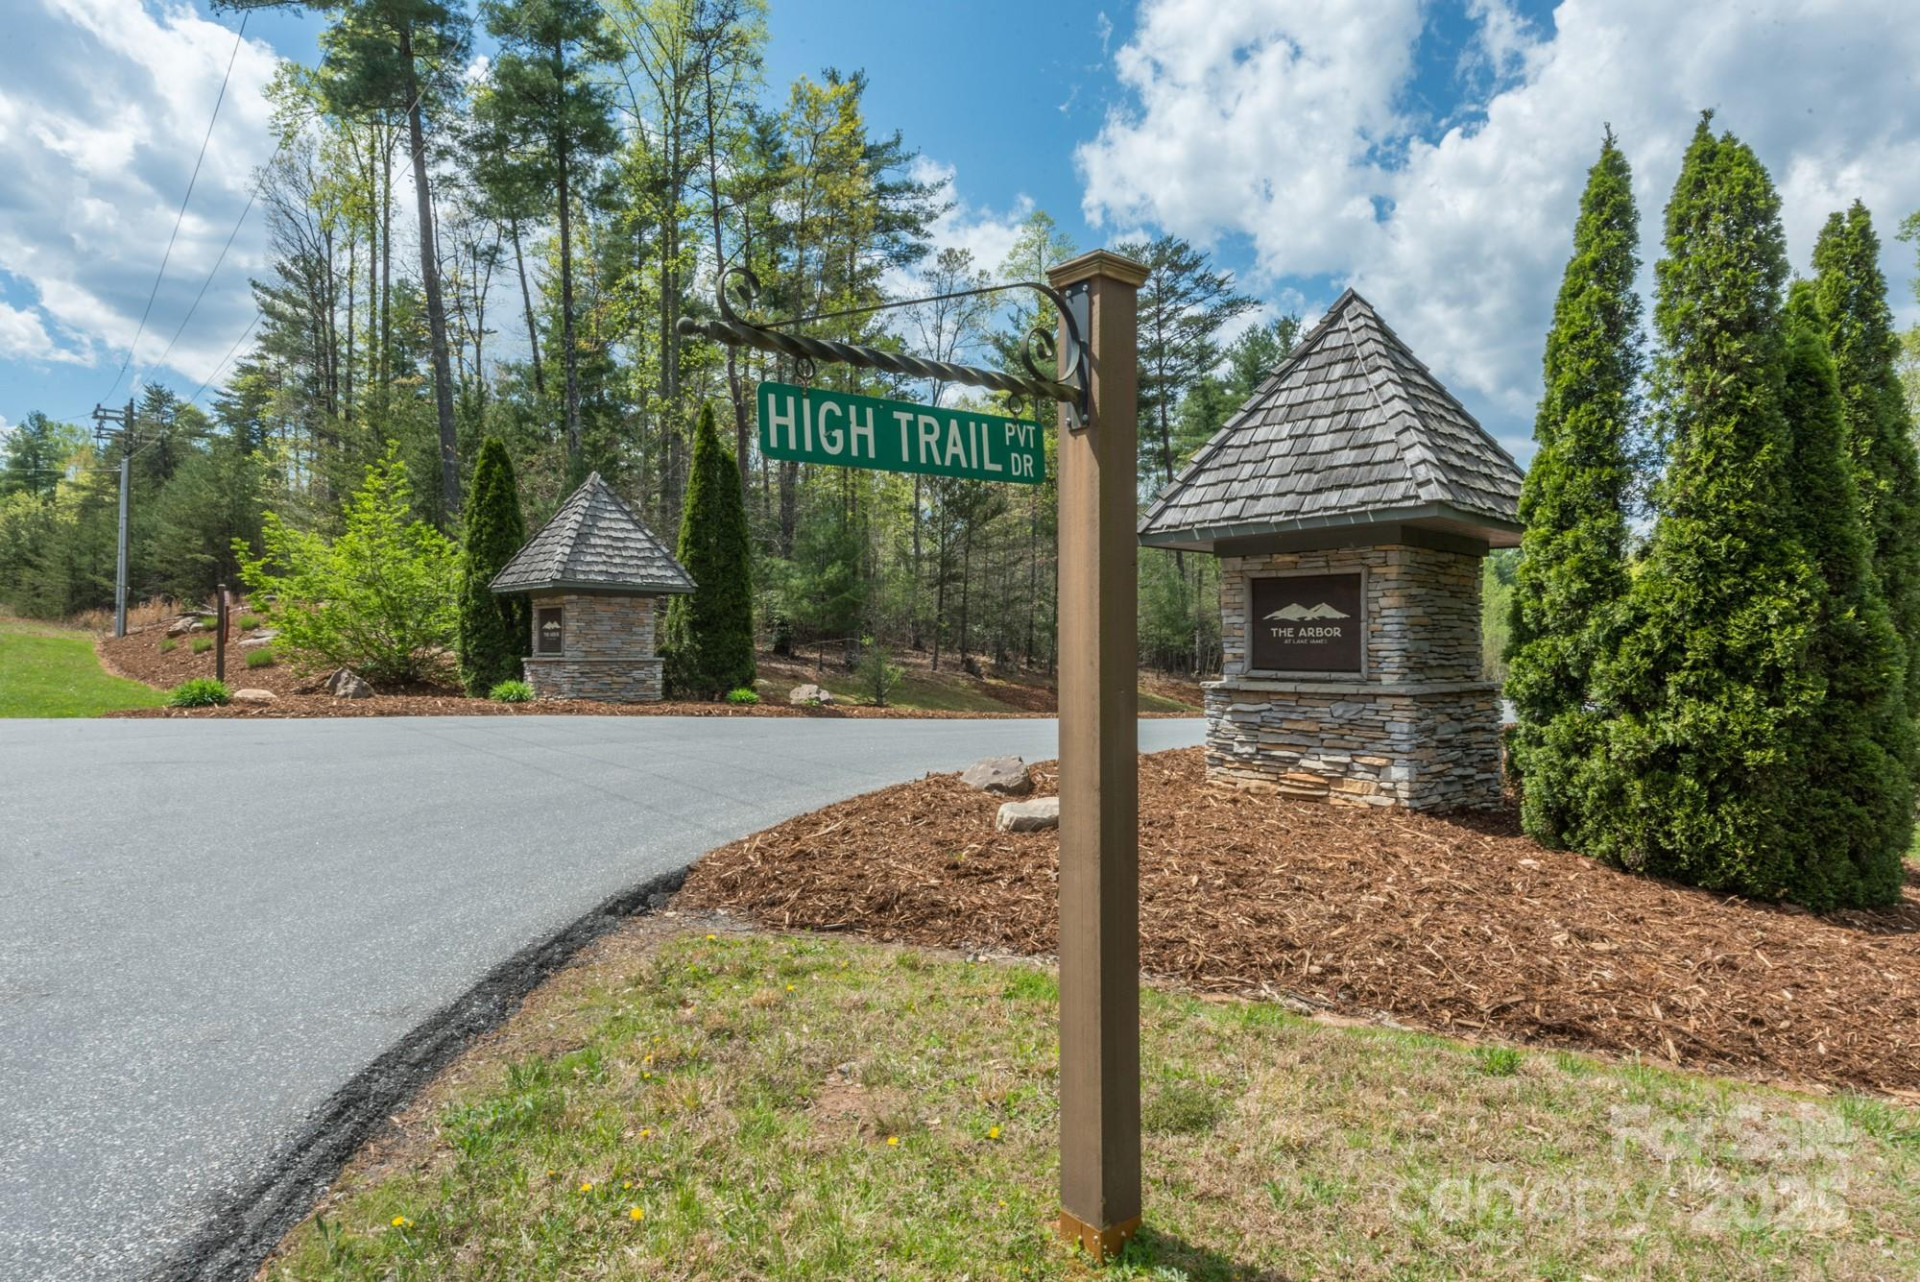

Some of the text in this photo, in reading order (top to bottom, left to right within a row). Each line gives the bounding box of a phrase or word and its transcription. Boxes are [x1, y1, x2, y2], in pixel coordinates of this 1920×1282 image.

[768, 393, 1003, 472] HIGH TRAIL
[1004, 422, 1036, 449] PVT
[1011, 453, 1034, 477] DR
[1270, 627, 1342, 637] THE ARBOR
